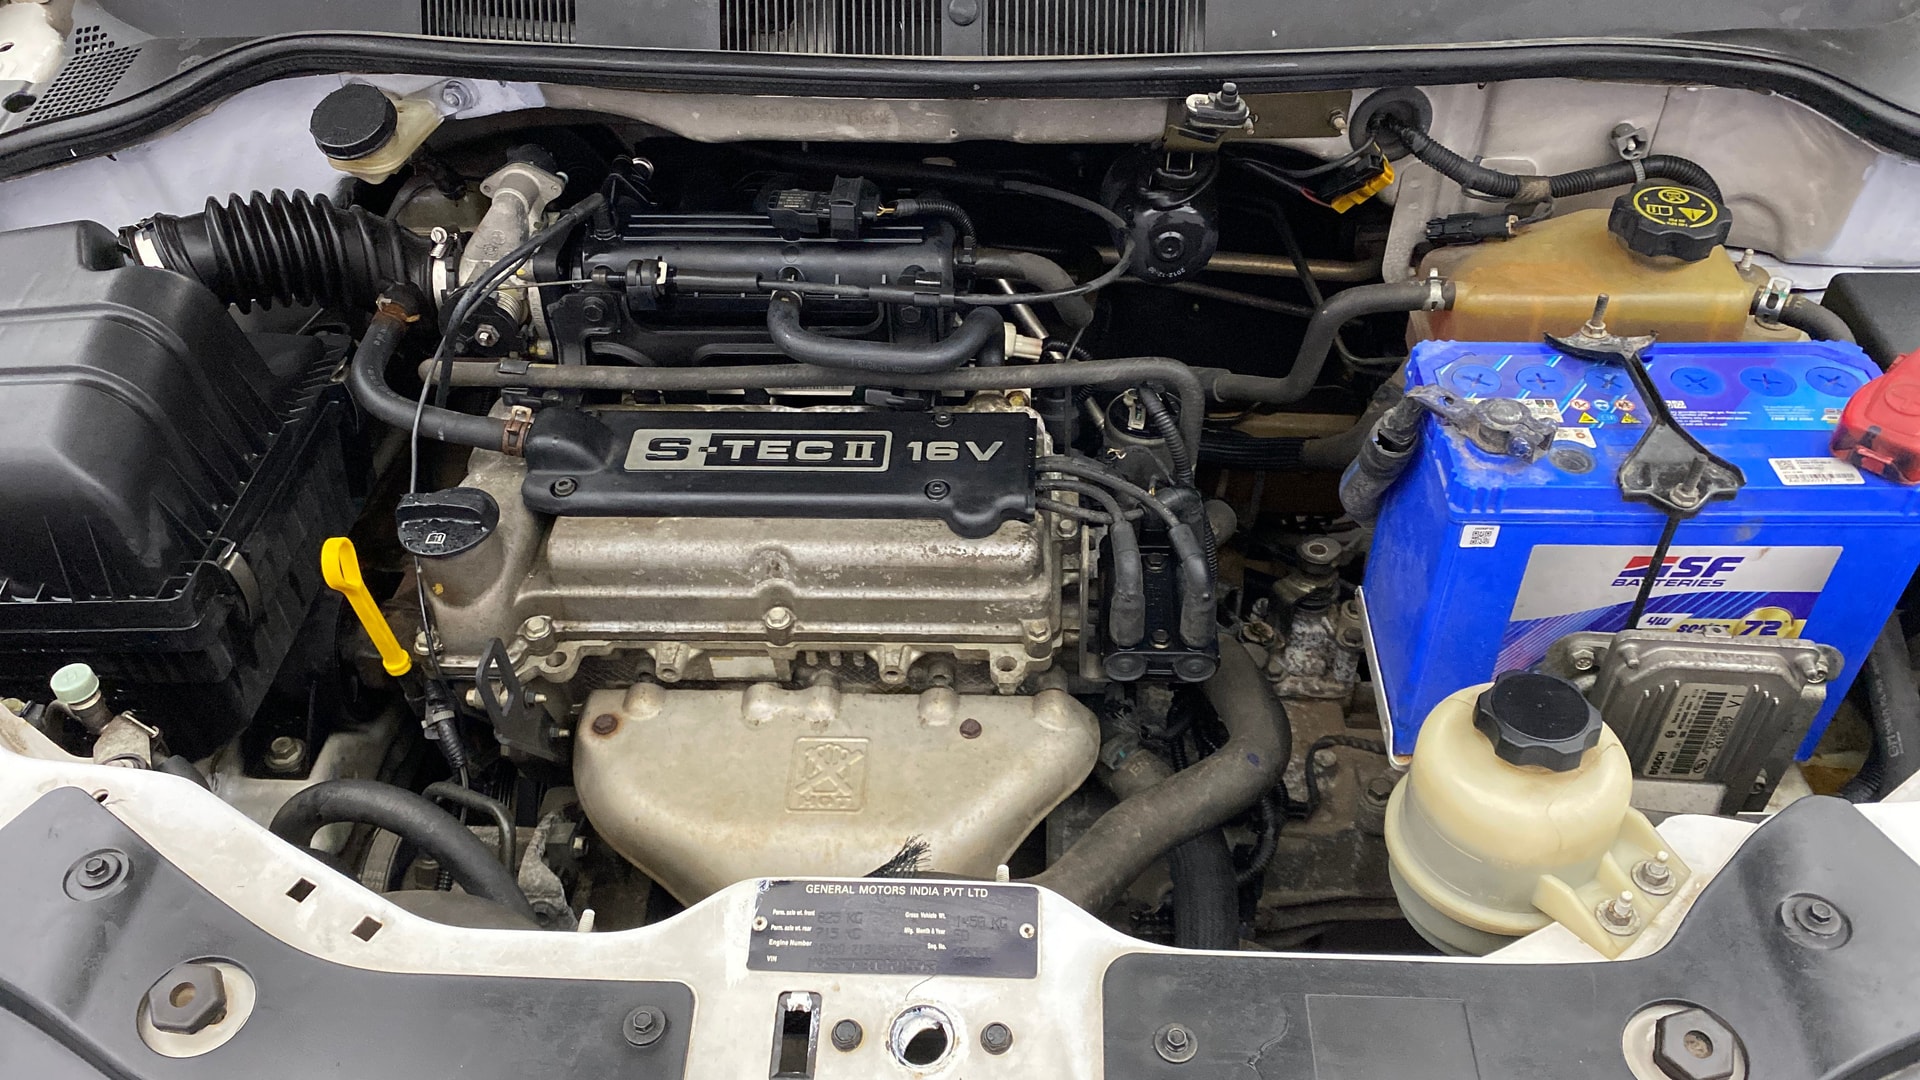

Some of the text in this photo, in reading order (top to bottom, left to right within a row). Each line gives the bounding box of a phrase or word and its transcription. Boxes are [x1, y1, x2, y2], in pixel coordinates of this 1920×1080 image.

[645, 437, 1004, 461] S-TEC II 16V
[1611, 578, 1727, 587] BATERIES
[1648, 751, 1668, 775] BOSCH
[799, 795, 853, 809] HOT
[805, 884, 989, 898] GENERAL MOTORS INDIA PVT LTD
[768, 938, 813, 948] Engine Number
[766, 954, 778, 963] VIN
